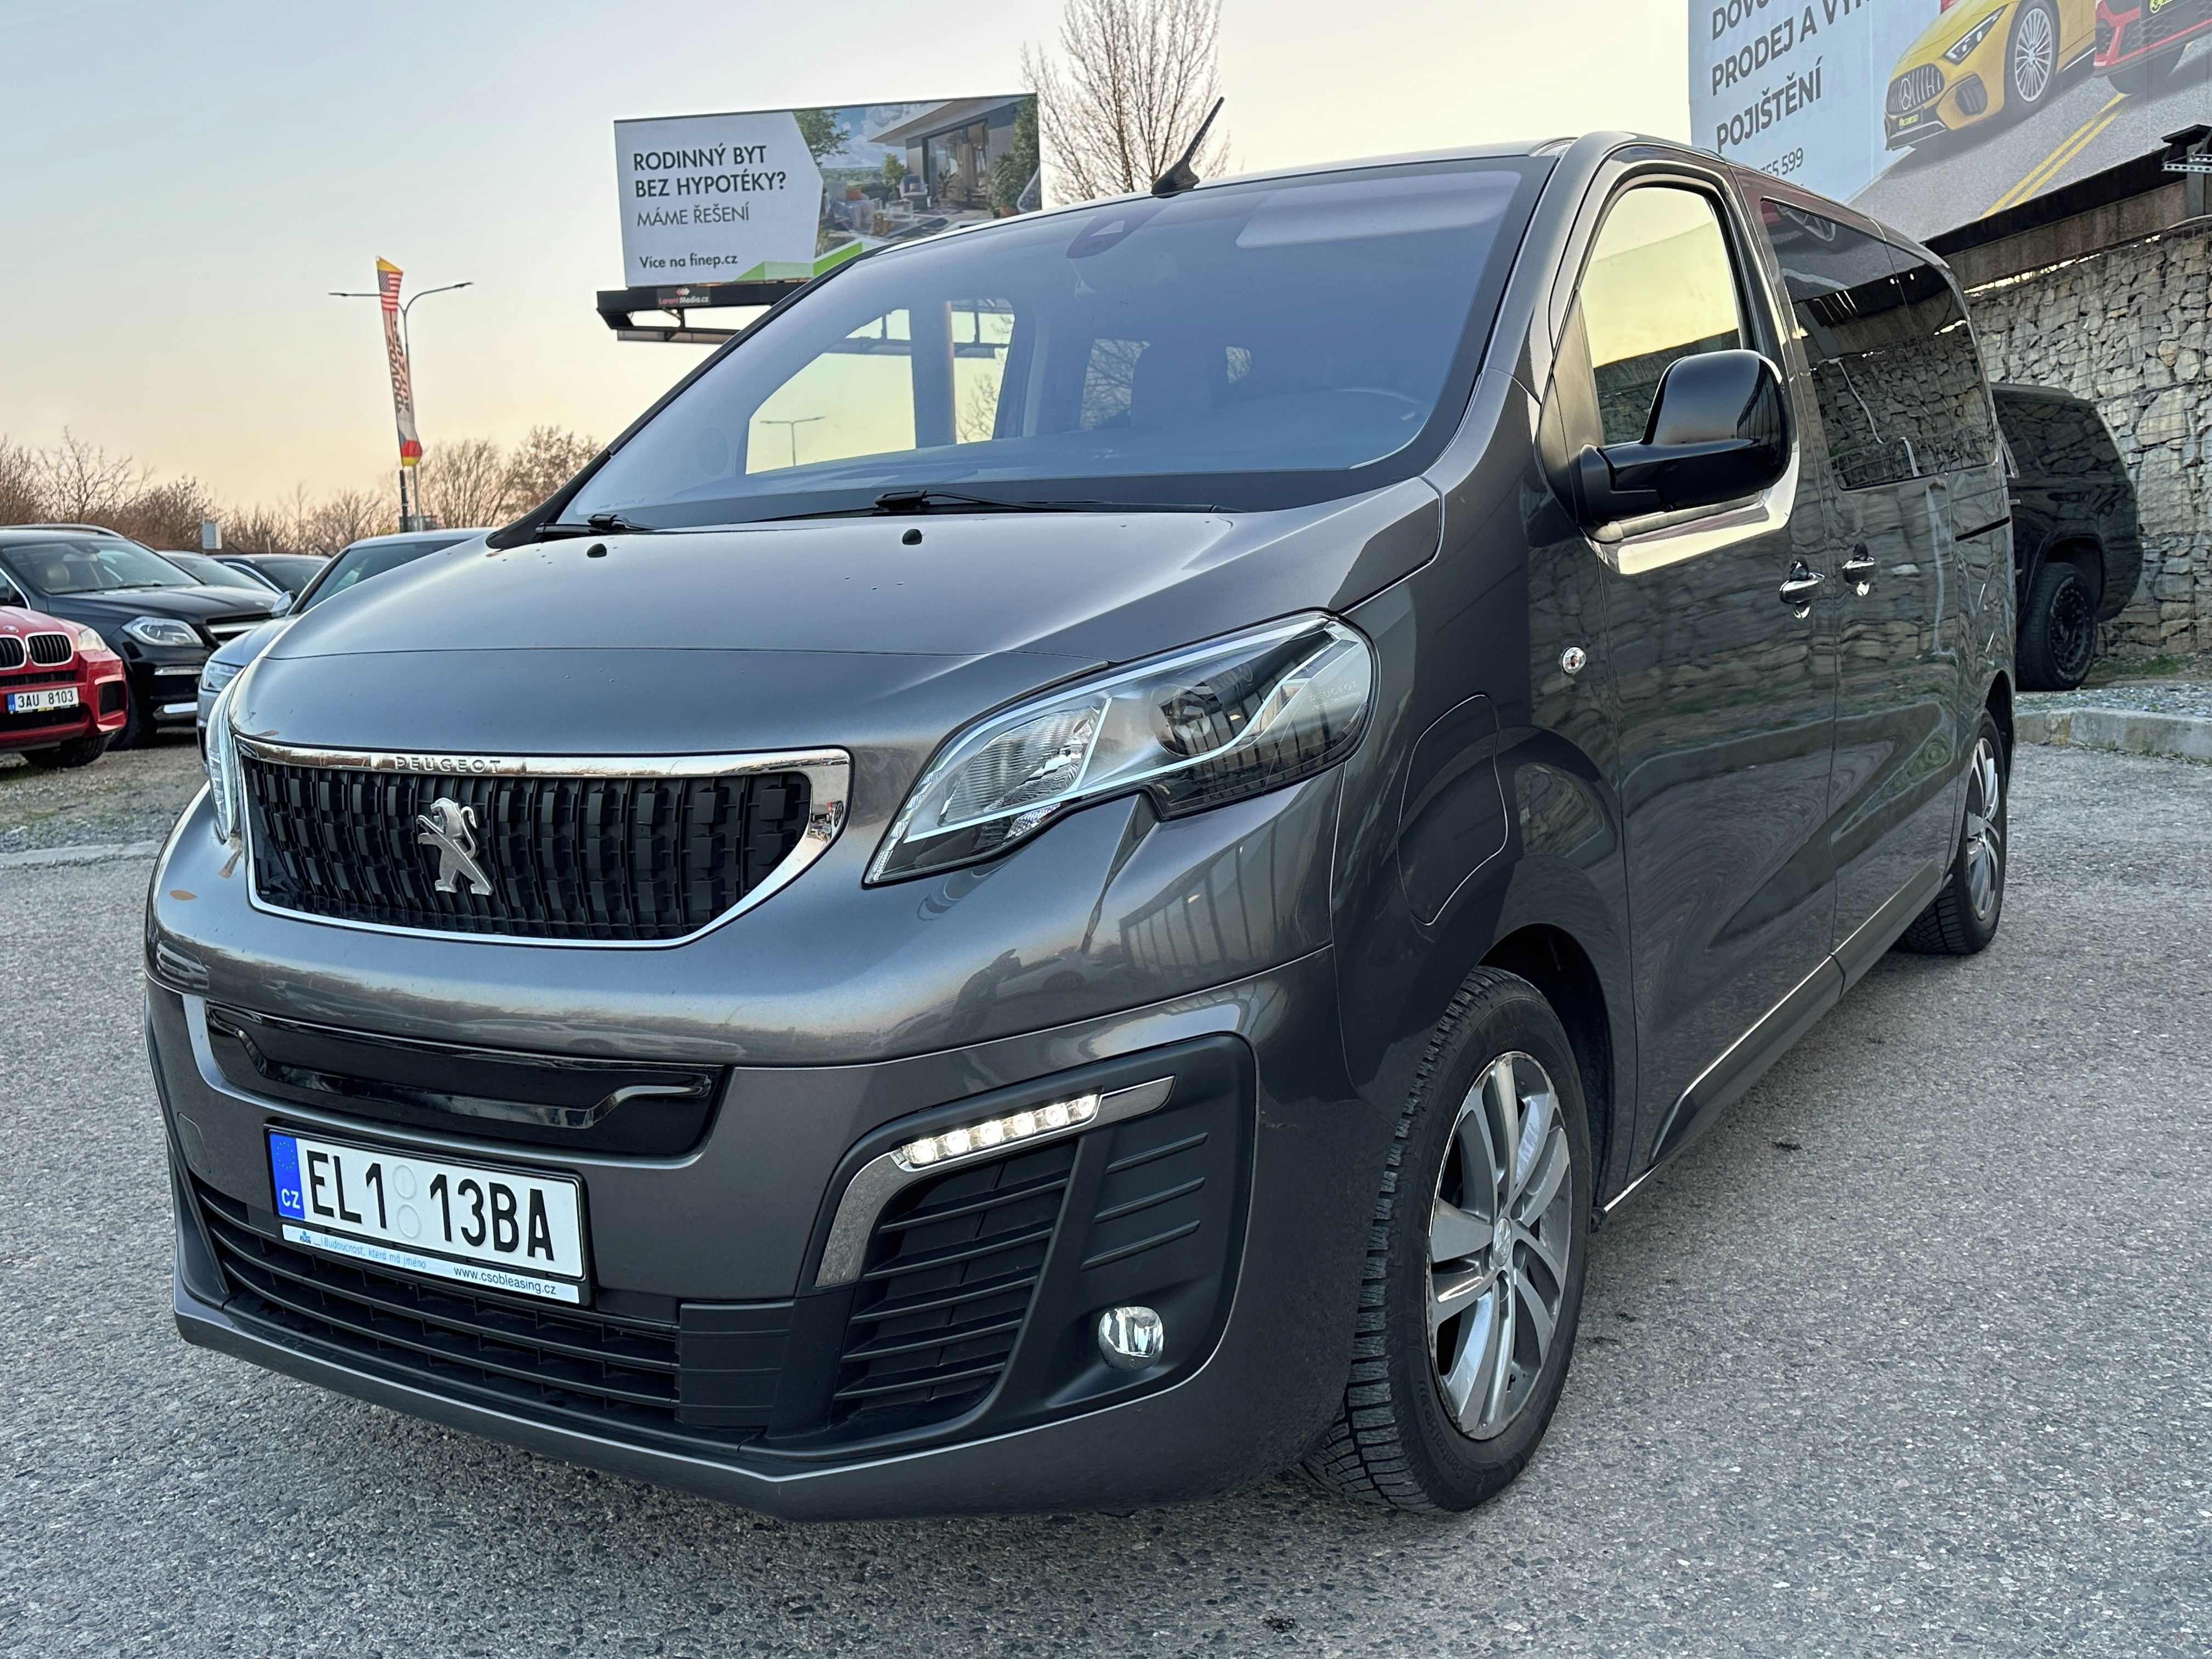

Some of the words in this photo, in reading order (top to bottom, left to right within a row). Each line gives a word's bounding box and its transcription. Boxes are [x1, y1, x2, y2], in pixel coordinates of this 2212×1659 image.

[1712, 16, 1793, 96] PRODEJ
[1799, 5, 1818, 43] A
[1717, 55, 1823, 154] POJIŠTĚNÍ
[634, 143, 726, 171] RODINNÝ
[733, 145, 766, 165] BYT
[1781, 147, 1803, 175] 599
[635, 178, 670, 198] BEZ
[677, 168, 786, 196] HYPOTÉKY?
[637, 207, 688, 227] MÁME
[693, 202, 749, 224] ŘEŠENÍ
[639, 256, 666, 268] Více
[670, 258, 686, 267] na
[690, 252, 738, 269] finep.cz
[18, 694, 39, 708] 3AU
[48, 690, 74, 704] 8103
[1309, 681, 1357, 702] PEUGEOT
[395, 757, 500, 774] PEUGEOT
[281, 1188, 301, 1209] CZ
[429, 1173, 555, 1261] 13BA
[403, 1255, 426, 1269] jméno
[454, 1267, 557, 1295] www.csobleasing.cz
